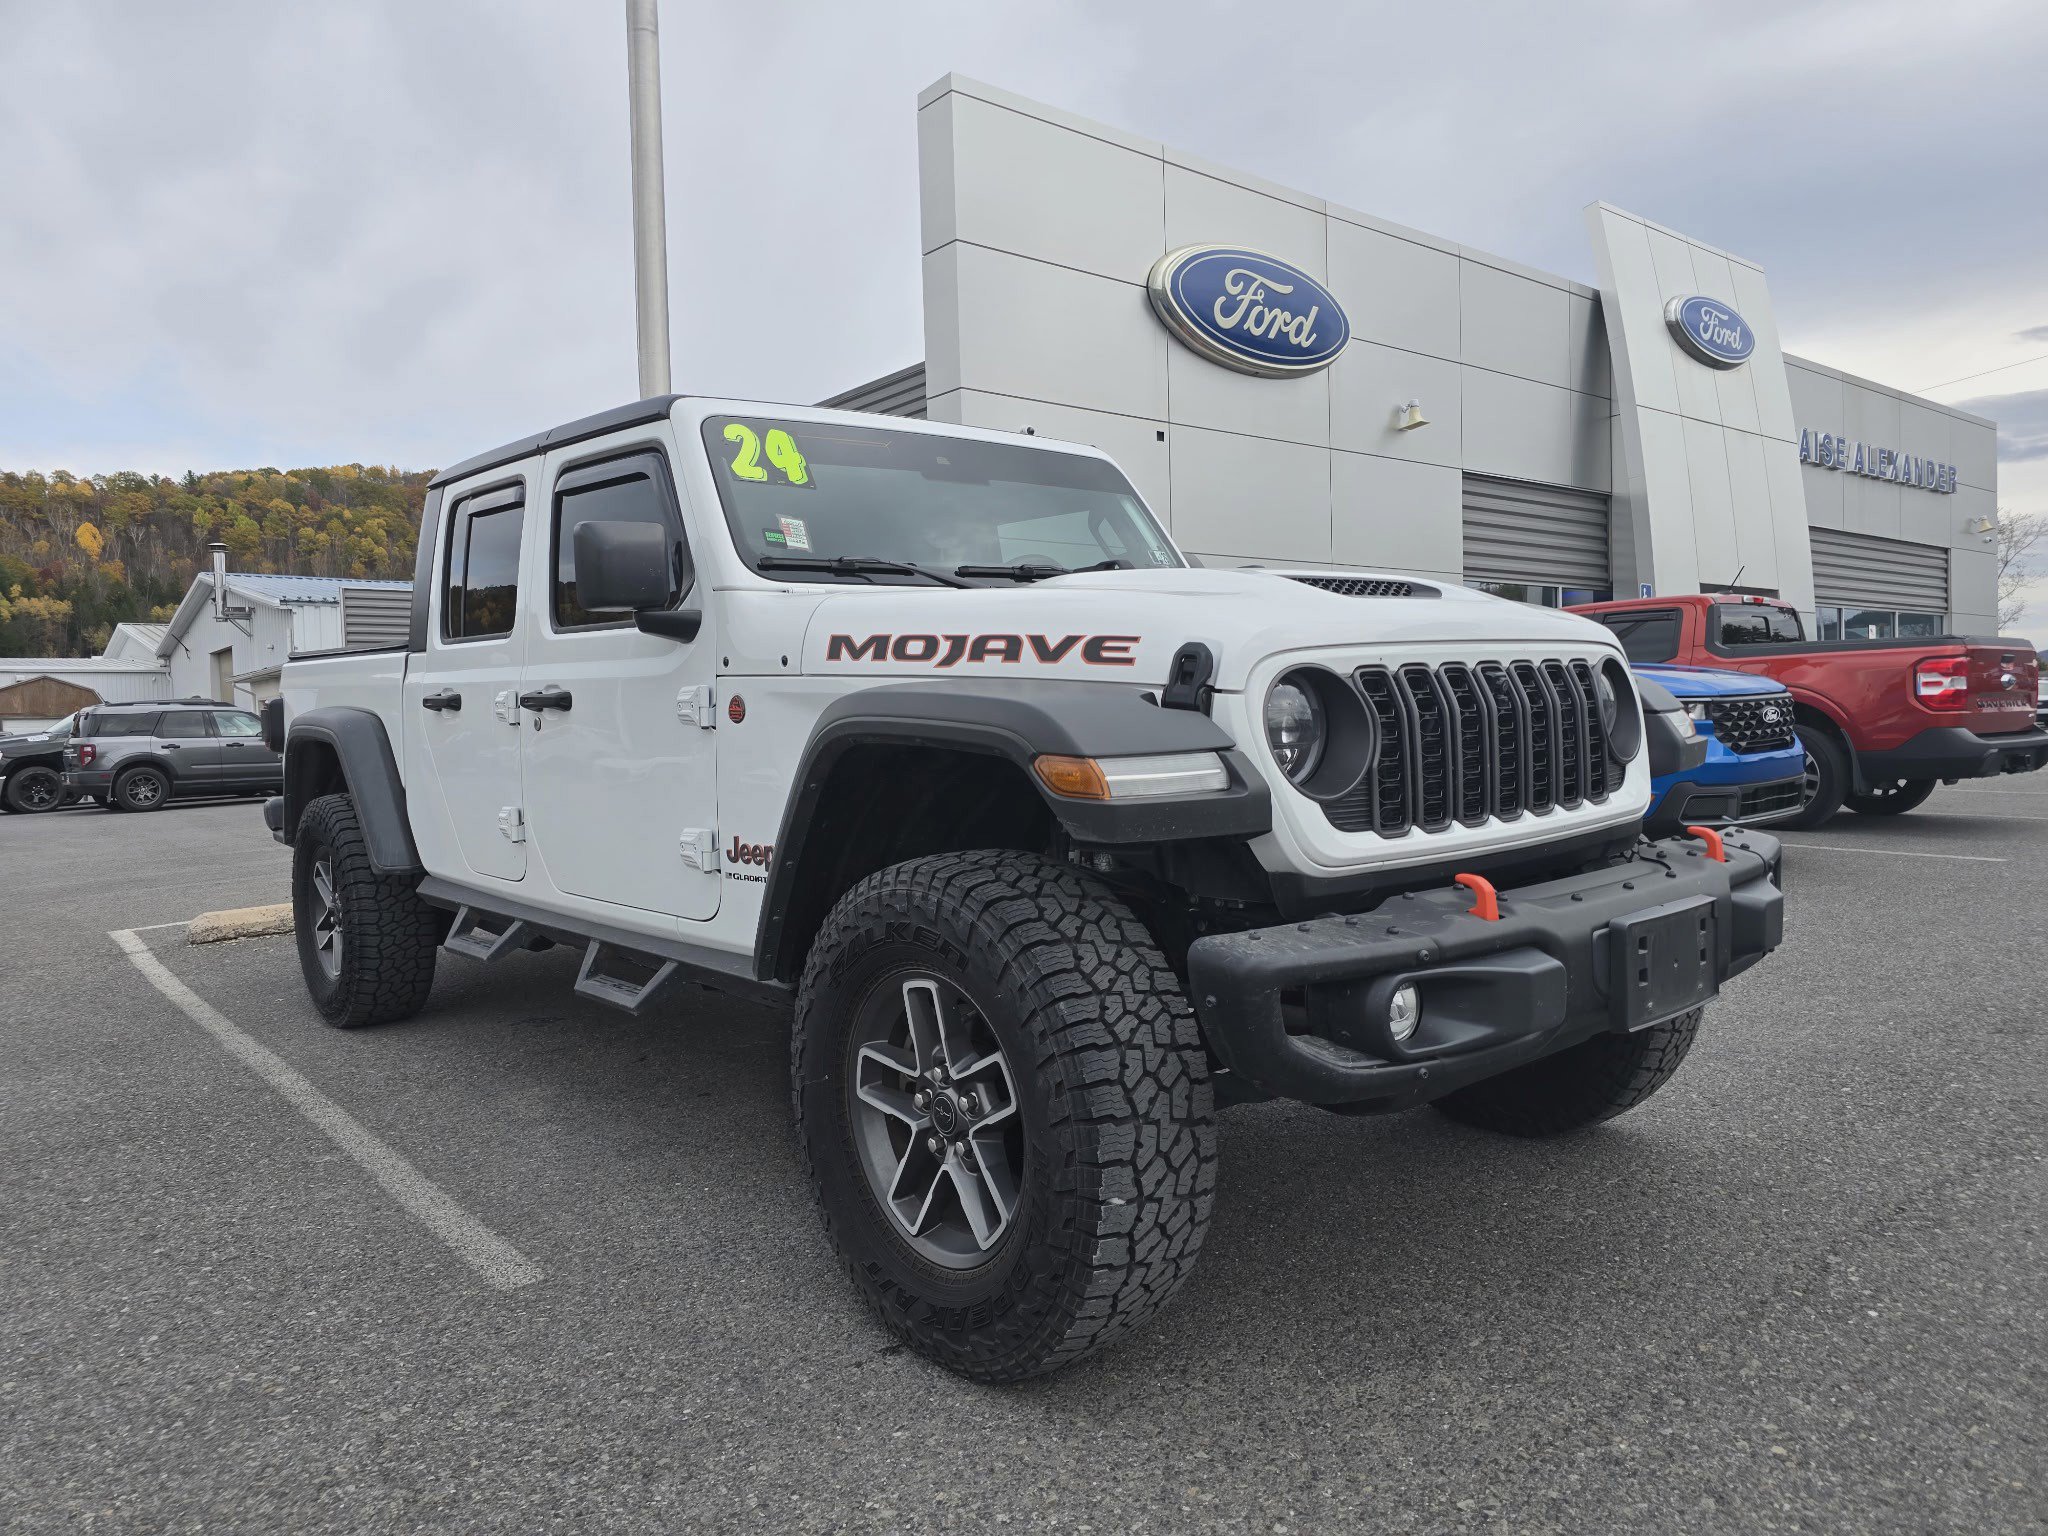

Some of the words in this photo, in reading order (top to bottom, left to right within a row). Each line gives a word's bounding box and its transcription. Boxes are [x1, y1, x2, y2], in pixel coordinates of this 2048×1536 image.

[1213, 268, 1319, 348] Ford
[1700, 306, 1742, 350] Ford
[723, 423, 809, 484] 24
[1850, 441, 1958, 494] ALEXANDER
[825, 633, 1142, 669] MOJAVE
[726, 835, 776, 872] Jeep
[828, 919, 968, 986] FALKEN
